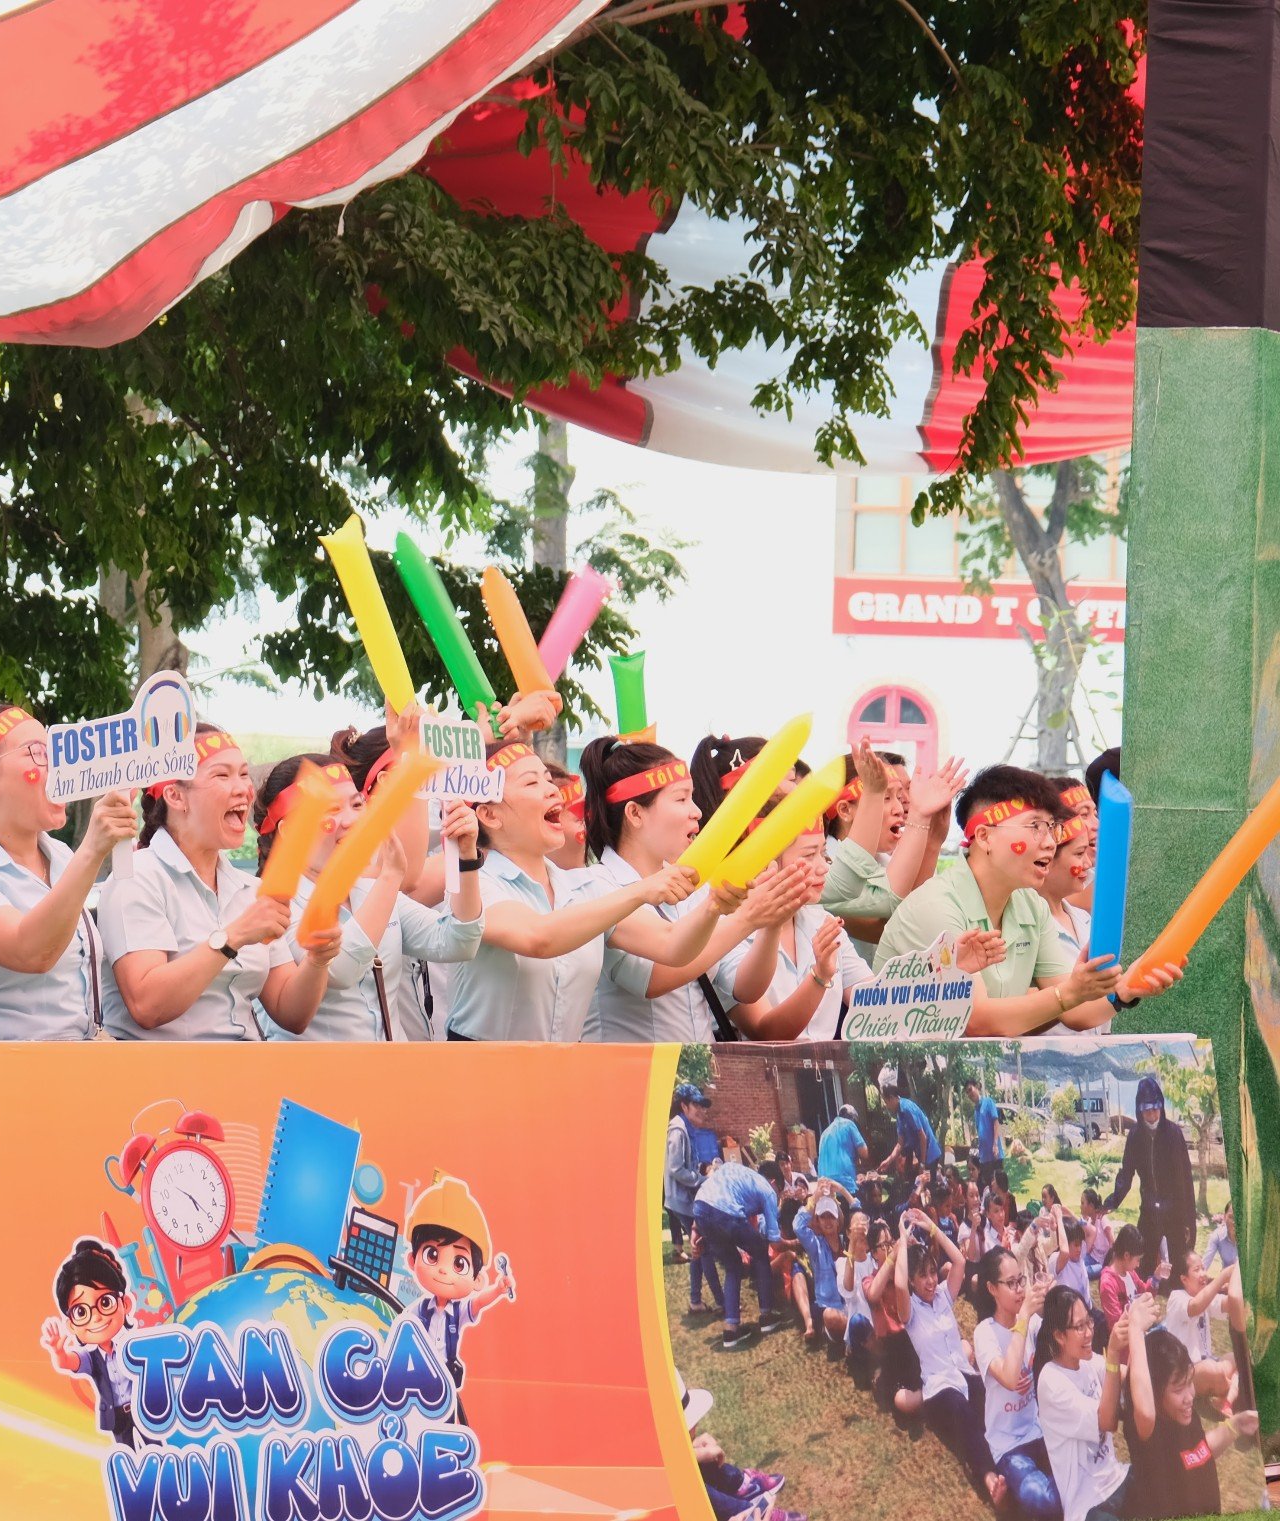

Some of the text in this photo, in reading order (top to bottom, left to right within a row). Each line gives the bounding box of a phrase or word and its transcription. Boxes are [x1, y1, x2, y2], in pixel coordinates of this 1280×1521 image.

[848, 592, 983, 625] GRAND
[991, 597, 1019, 626] T
[51, 718, 138, 767] FOSTER
[424, 724, 481, 760] FOSTER
[52, 770, 75, 798] Âm
[79, 766, 121, 792] Thanh
[126, 756, 159, 784] Cuộc
[163, 746, 195, 776] Sống
[443, 765, 490, 796] Khỏe
[853, 979, 889, 1007] MUỐN
[891, 984, 911, 1005] VUI
[913, 978, 940, 1003] PHẢI
[846, 1013, 899, 1041] Chiến
[123, 1318, 456, 1431] TAN CA
[107, 1415, 483, 1521] VUI KHỎE
